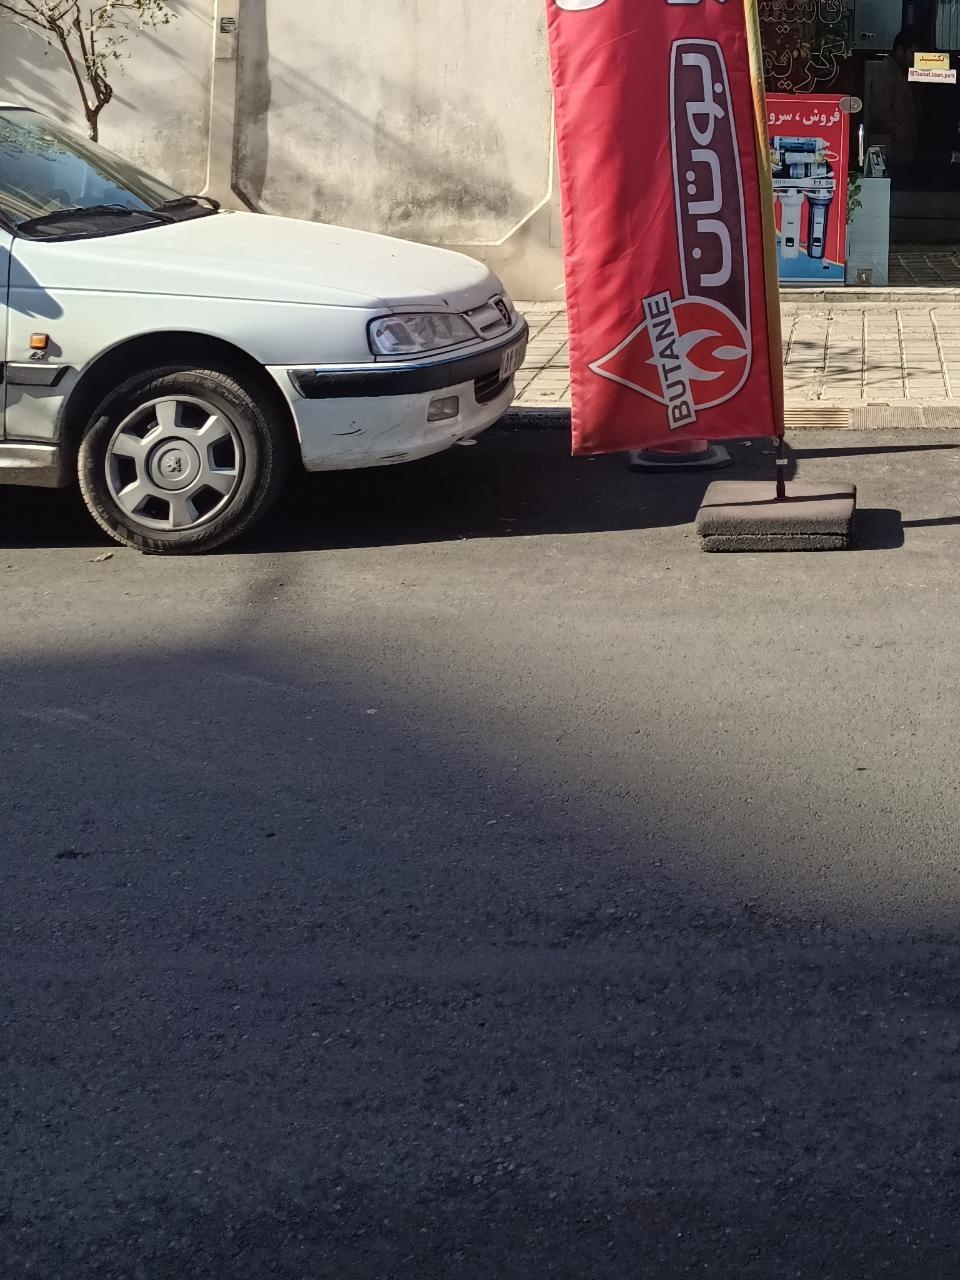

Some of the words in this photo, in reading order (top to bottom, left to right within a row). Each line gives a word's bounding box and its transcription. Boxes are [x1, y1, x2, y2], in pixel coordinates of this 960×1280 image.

[768, 110, 793, 126] سرو
[803, 108, 840, 126] فروش
[685, 52, 733, 288] بوتان
[648, 294, 692, 424] BUTANE
